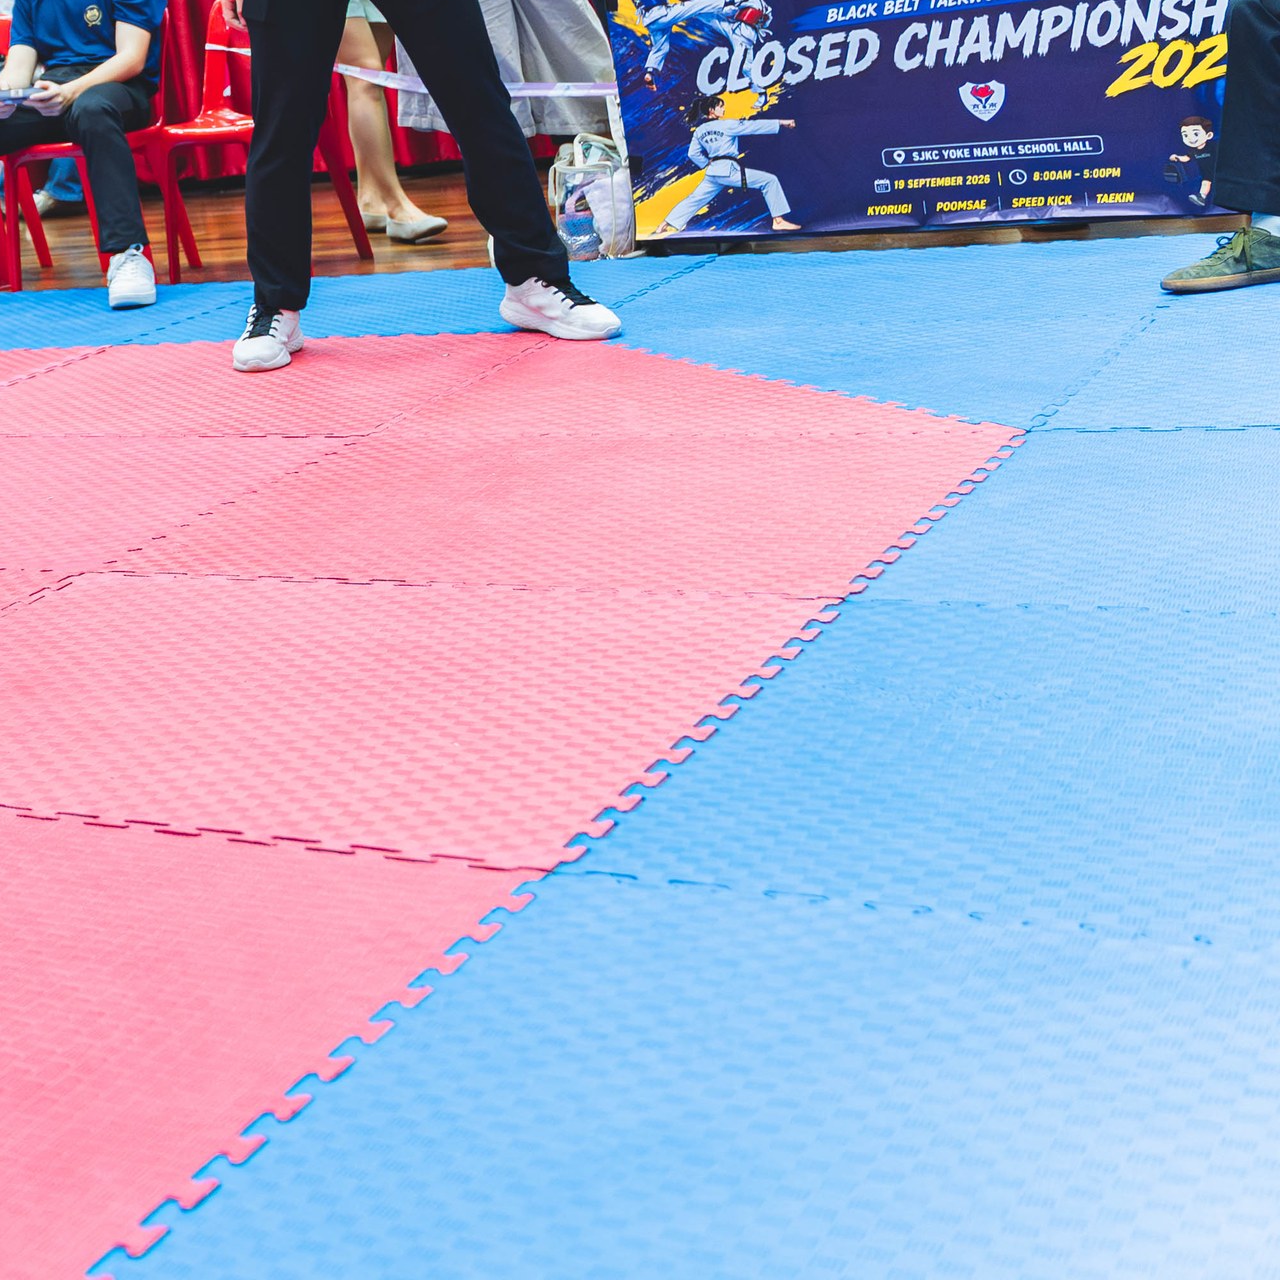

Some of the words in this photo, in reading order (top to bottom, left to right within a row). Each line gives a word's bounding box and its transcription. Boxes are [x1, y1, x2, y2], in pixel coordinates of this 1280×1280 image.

[826, 2, 878, 24] BLACK
[695, 28, 880, 97] CLOSED
[1104, 32, 1229, 98] 202
[912, 150, 940, 162] SJKC
[942, 147, 971, 160] YOKE
[973, 146, 999, 159] NAM
[1001, 145, 1016, 156] KL
[1017, 141, 1062, 155] SCHOOL
[1064, 140, 1093, 152] HALL
[1033, 169, 1072, 181] 8:00AM
[1083, 167, 1121, 179] 5:00PM
[894, 179, 905, 190] 19
[907, 176, 963, 189] SEPTEMBER
[966, 174, 991, 186] 2026
[1012, 196, 1045, 208] SPEED
[1047, 194, 1073, 206] KICK
[1096, 191, 1135, 204] TAEKIN
[867, 204, 912, 216] KYORUGI
[936, 199, 987, 212] POOMSAE
